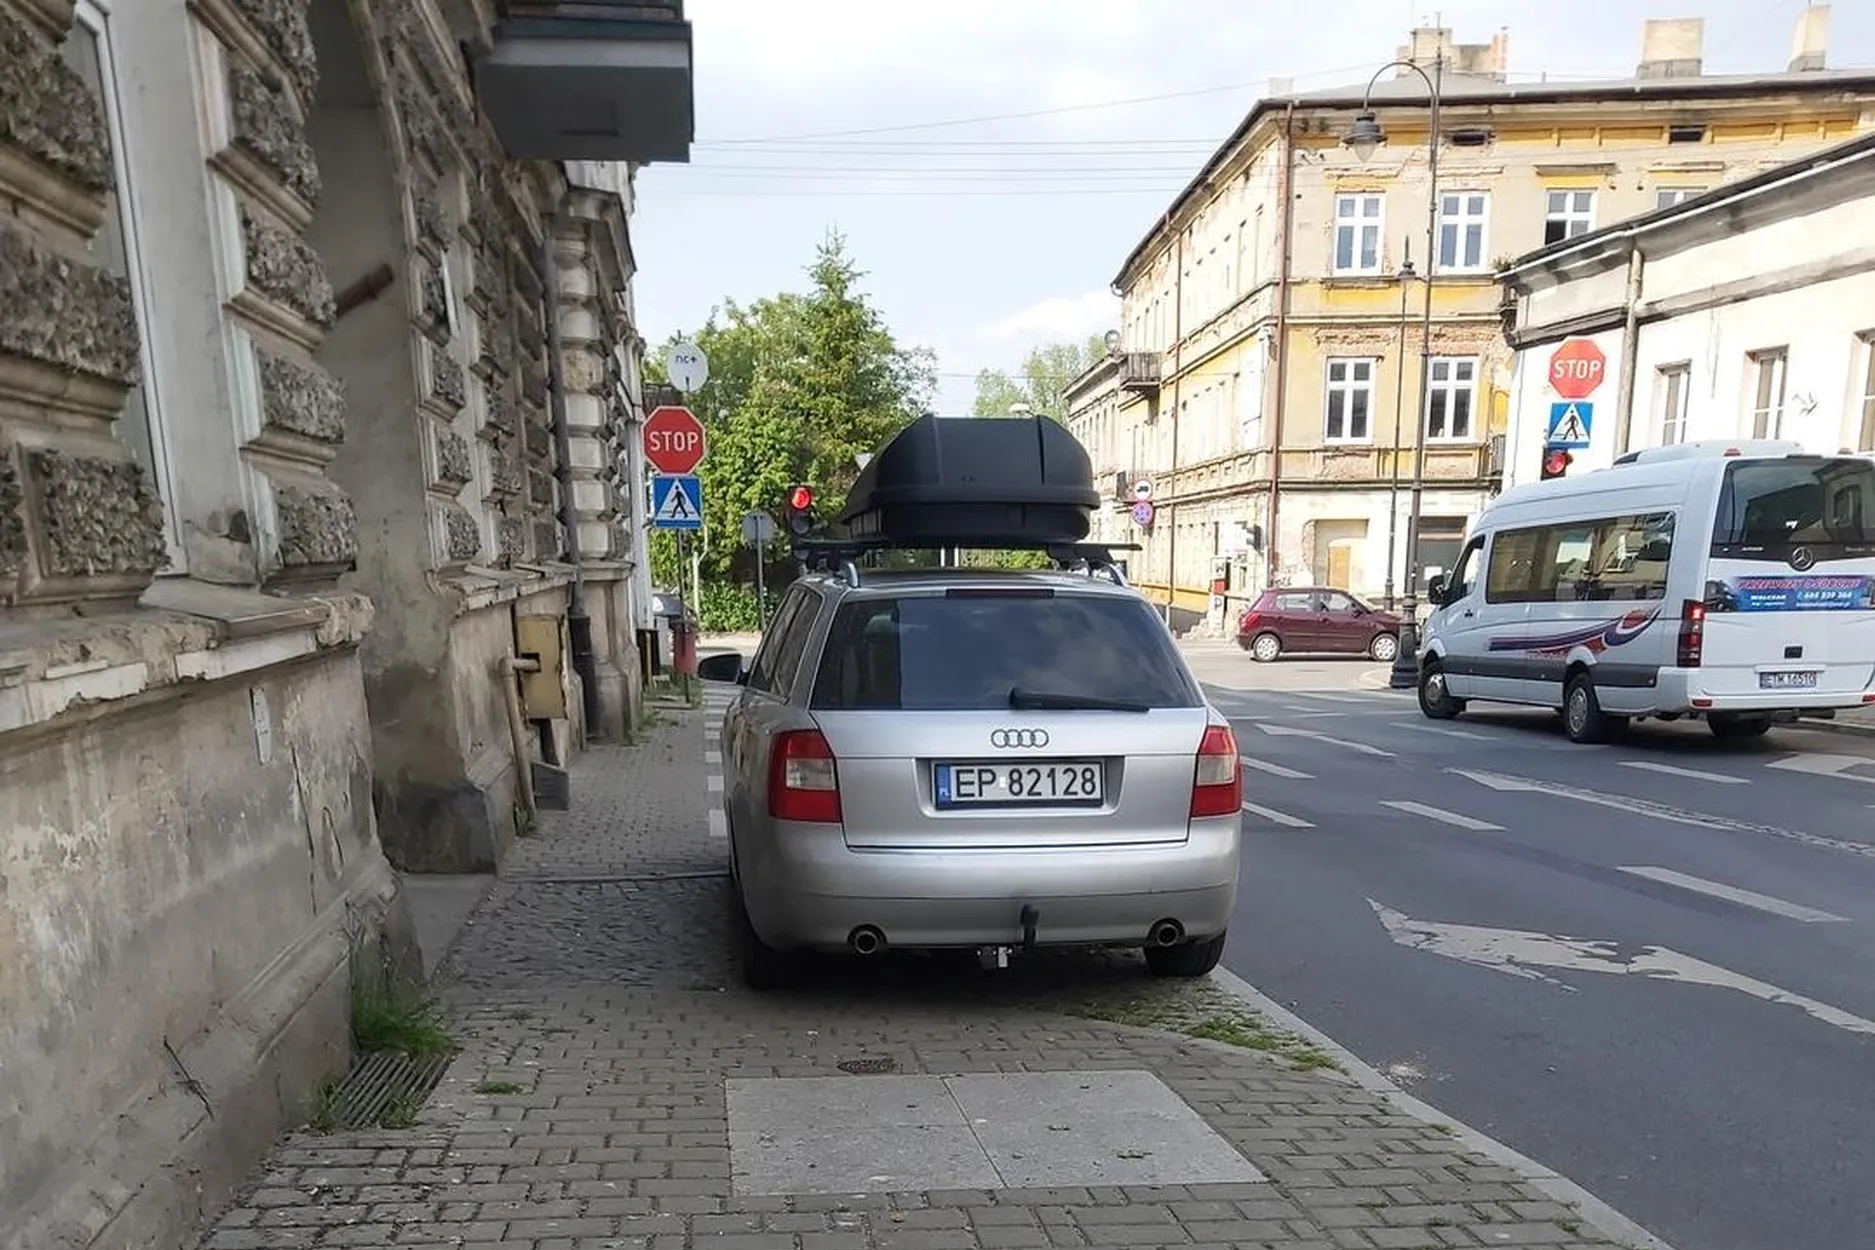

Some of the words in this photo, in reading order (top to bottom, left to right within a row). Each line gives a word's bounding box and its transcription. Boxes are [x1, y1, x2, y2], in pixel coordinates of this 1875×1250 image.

[1554, 359, 1601, 379] STOP
[649, 431, 699, 452] STOP
[956, 768, 997, 798] EP
[1008, 766, 1096, 797] 82128
